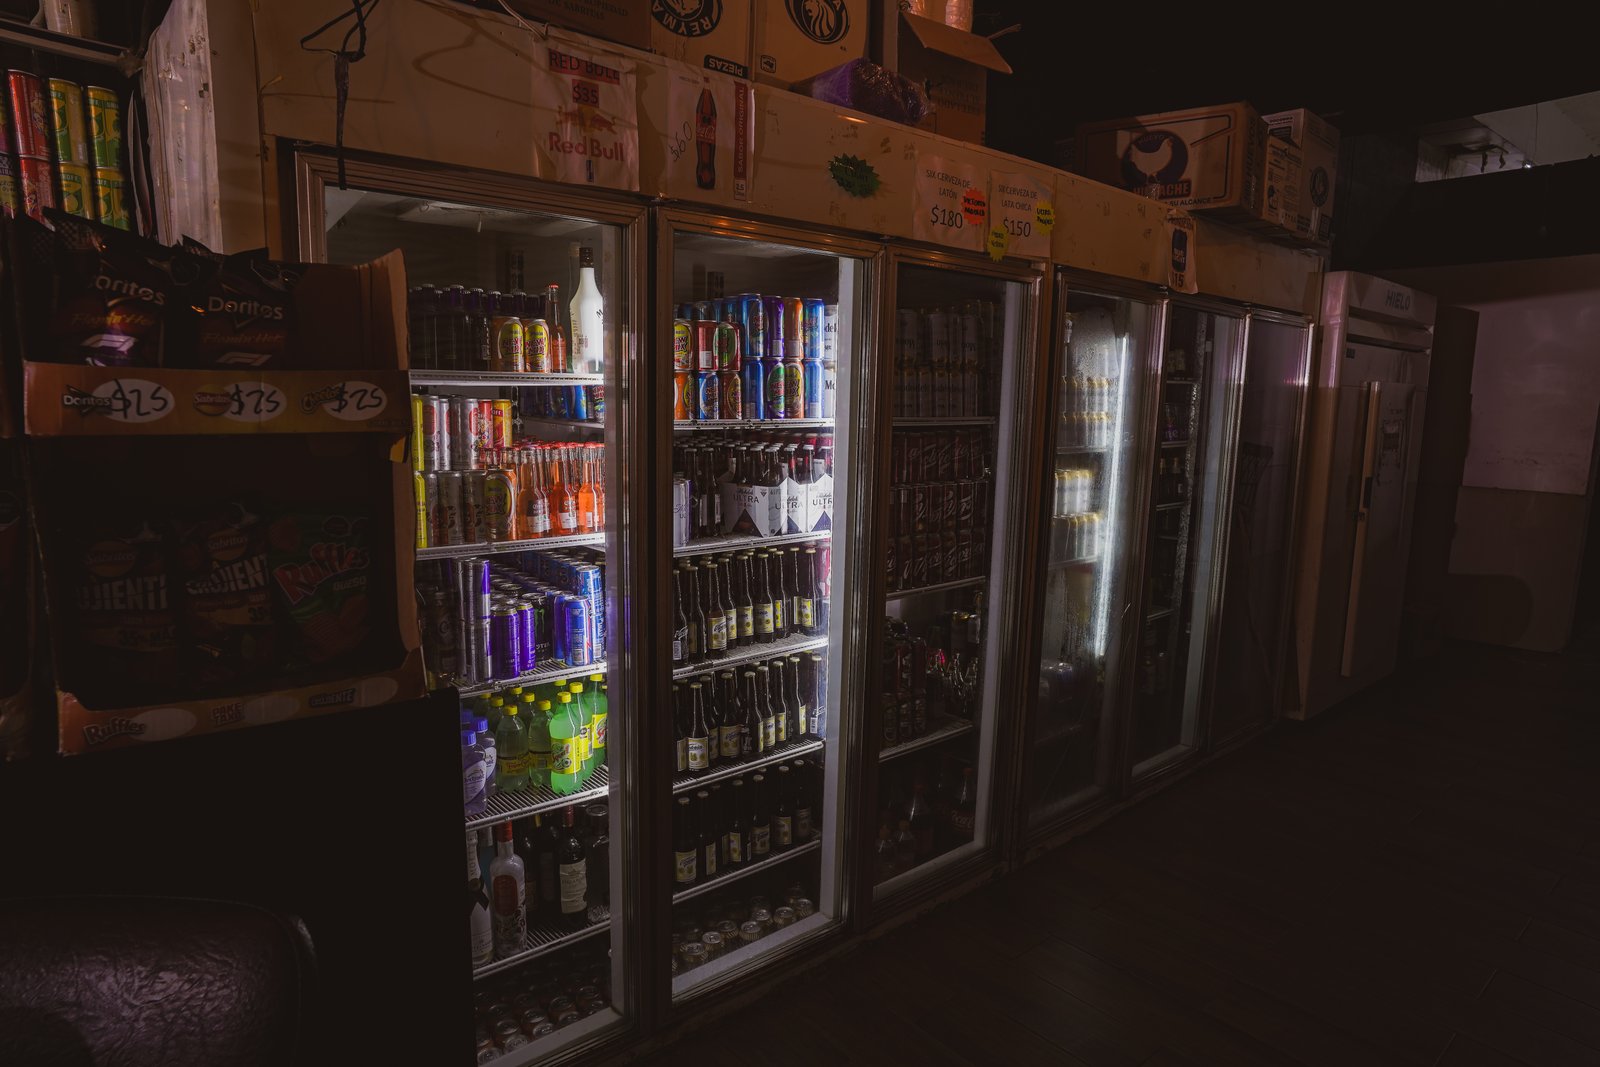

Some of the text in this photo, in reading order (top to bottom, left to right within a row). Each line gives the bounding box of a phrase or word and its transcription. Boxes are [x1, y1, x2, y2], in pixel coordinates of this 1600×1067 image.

[651, 3, 713, 35] REYMA
[549, 49, 620, 80] RED BULL
[708, 57, 743, 77] PIEZAS
[572, 82, 599, 104] $35
[548, 131, 624, 161] Red Bull
[668, 121, 693, 162] $60
[937, 172, 961, 188] CERVEZA
[961, 179, 971, 188] DE
[1006, 185, 1028, 198] CERVEZA
[1029, 191, 1038, 200] DE
[930, 203, 963, 230] $180
[1001, 200, 1032, 212] LATA CHICA
[1002, 216, 1031, 238] $150
[208, 295, 285, 320] Doritos
[1384, 289, 1411, 311] HIELO
[62, 393, 112, 407] Doritos
[112, 378, 168, 419] $25
[331, 382, 383, 413] $25
[734, 493, 760, 504] ULTRA
[272, 542, 370, 607] Ruffles
[84, 717, 146, 744] Ruffles
